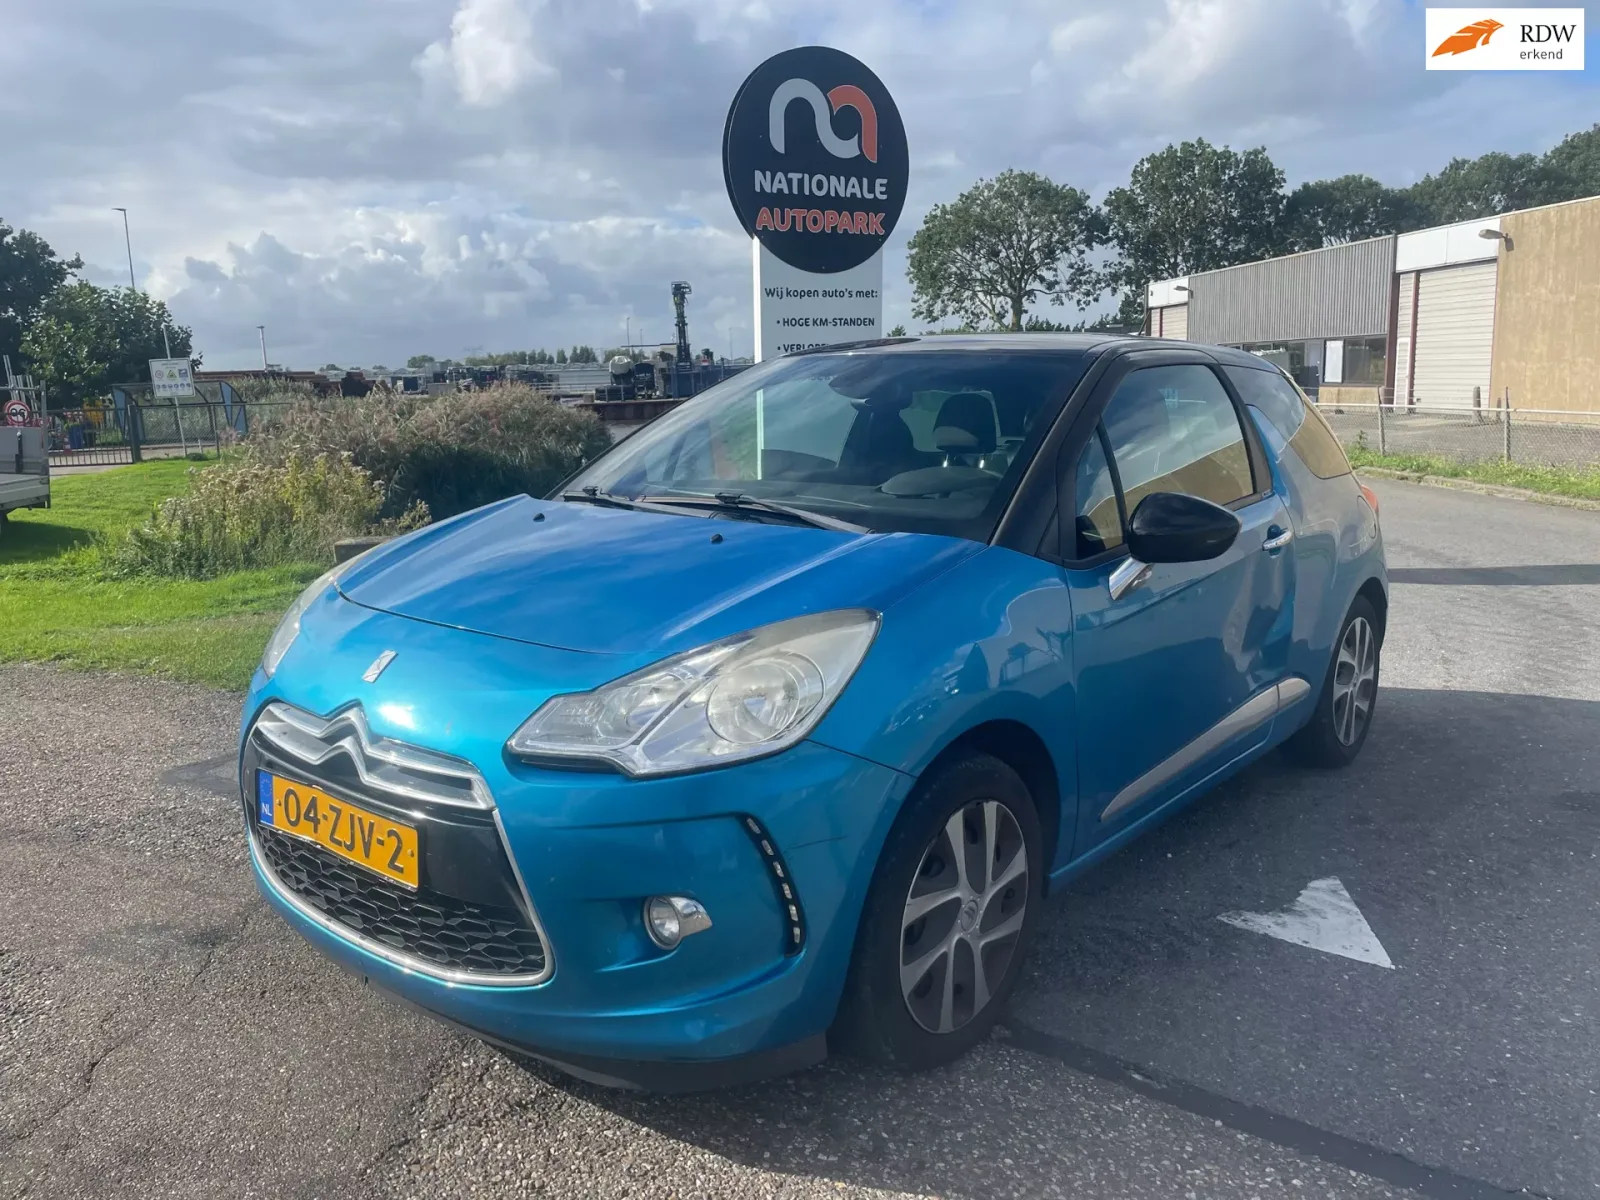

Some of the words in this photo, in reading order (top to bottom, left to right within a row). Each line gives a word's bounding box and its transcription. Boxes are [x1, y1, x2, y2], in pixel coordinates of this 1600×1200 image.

[754, 169, 888, 200] NATIONALE
[755, 206, 886, 235] AUTOPARK
[764, 287, 783, 300] Wij
[786, 287, 820, 299] kopen
[821, 288, 853, 298] auto's
[855, 289, 878, 298] met:
[782, 317, 811, 327] HOGE
[812, 317, 875, 327] KM-STANDEN
[261, 802, 273, 817] NL
[283, 787, 405, 875] 04-ZJV-2
